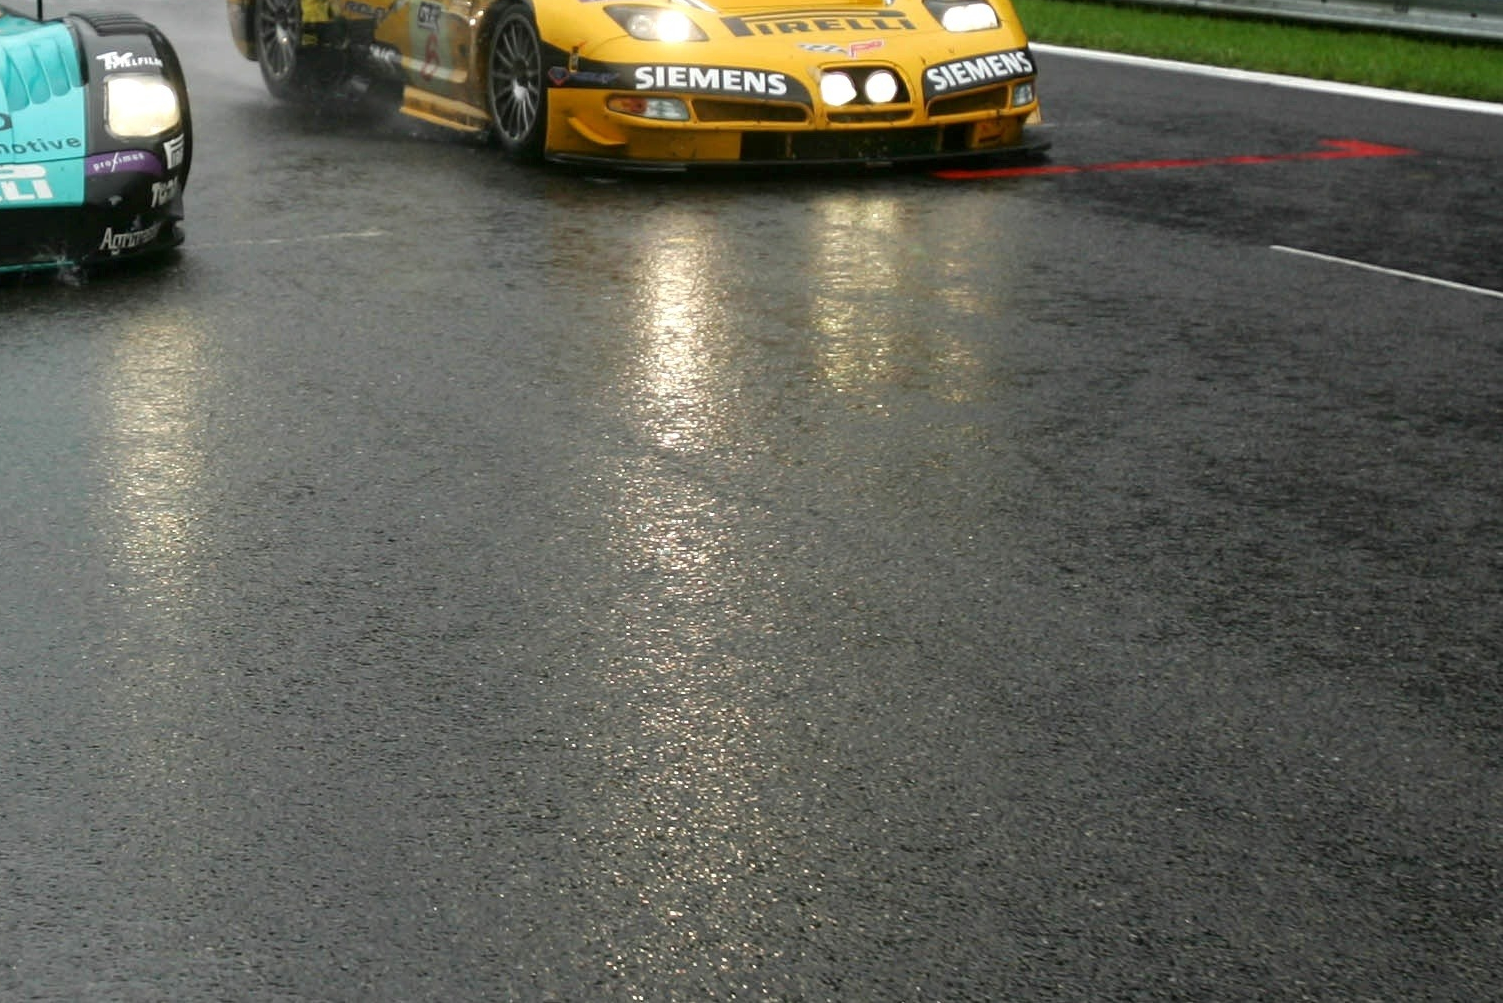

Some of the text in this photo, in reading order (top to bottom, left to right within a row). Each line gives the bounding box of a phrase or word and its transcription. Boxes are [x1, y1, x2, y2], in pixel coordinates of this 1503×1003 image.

[720, 9, 918, 38] PIRELLI
[634, 65, 788, 96] SIEMENS
[926, 49, 1034, 92] SIEMENS
